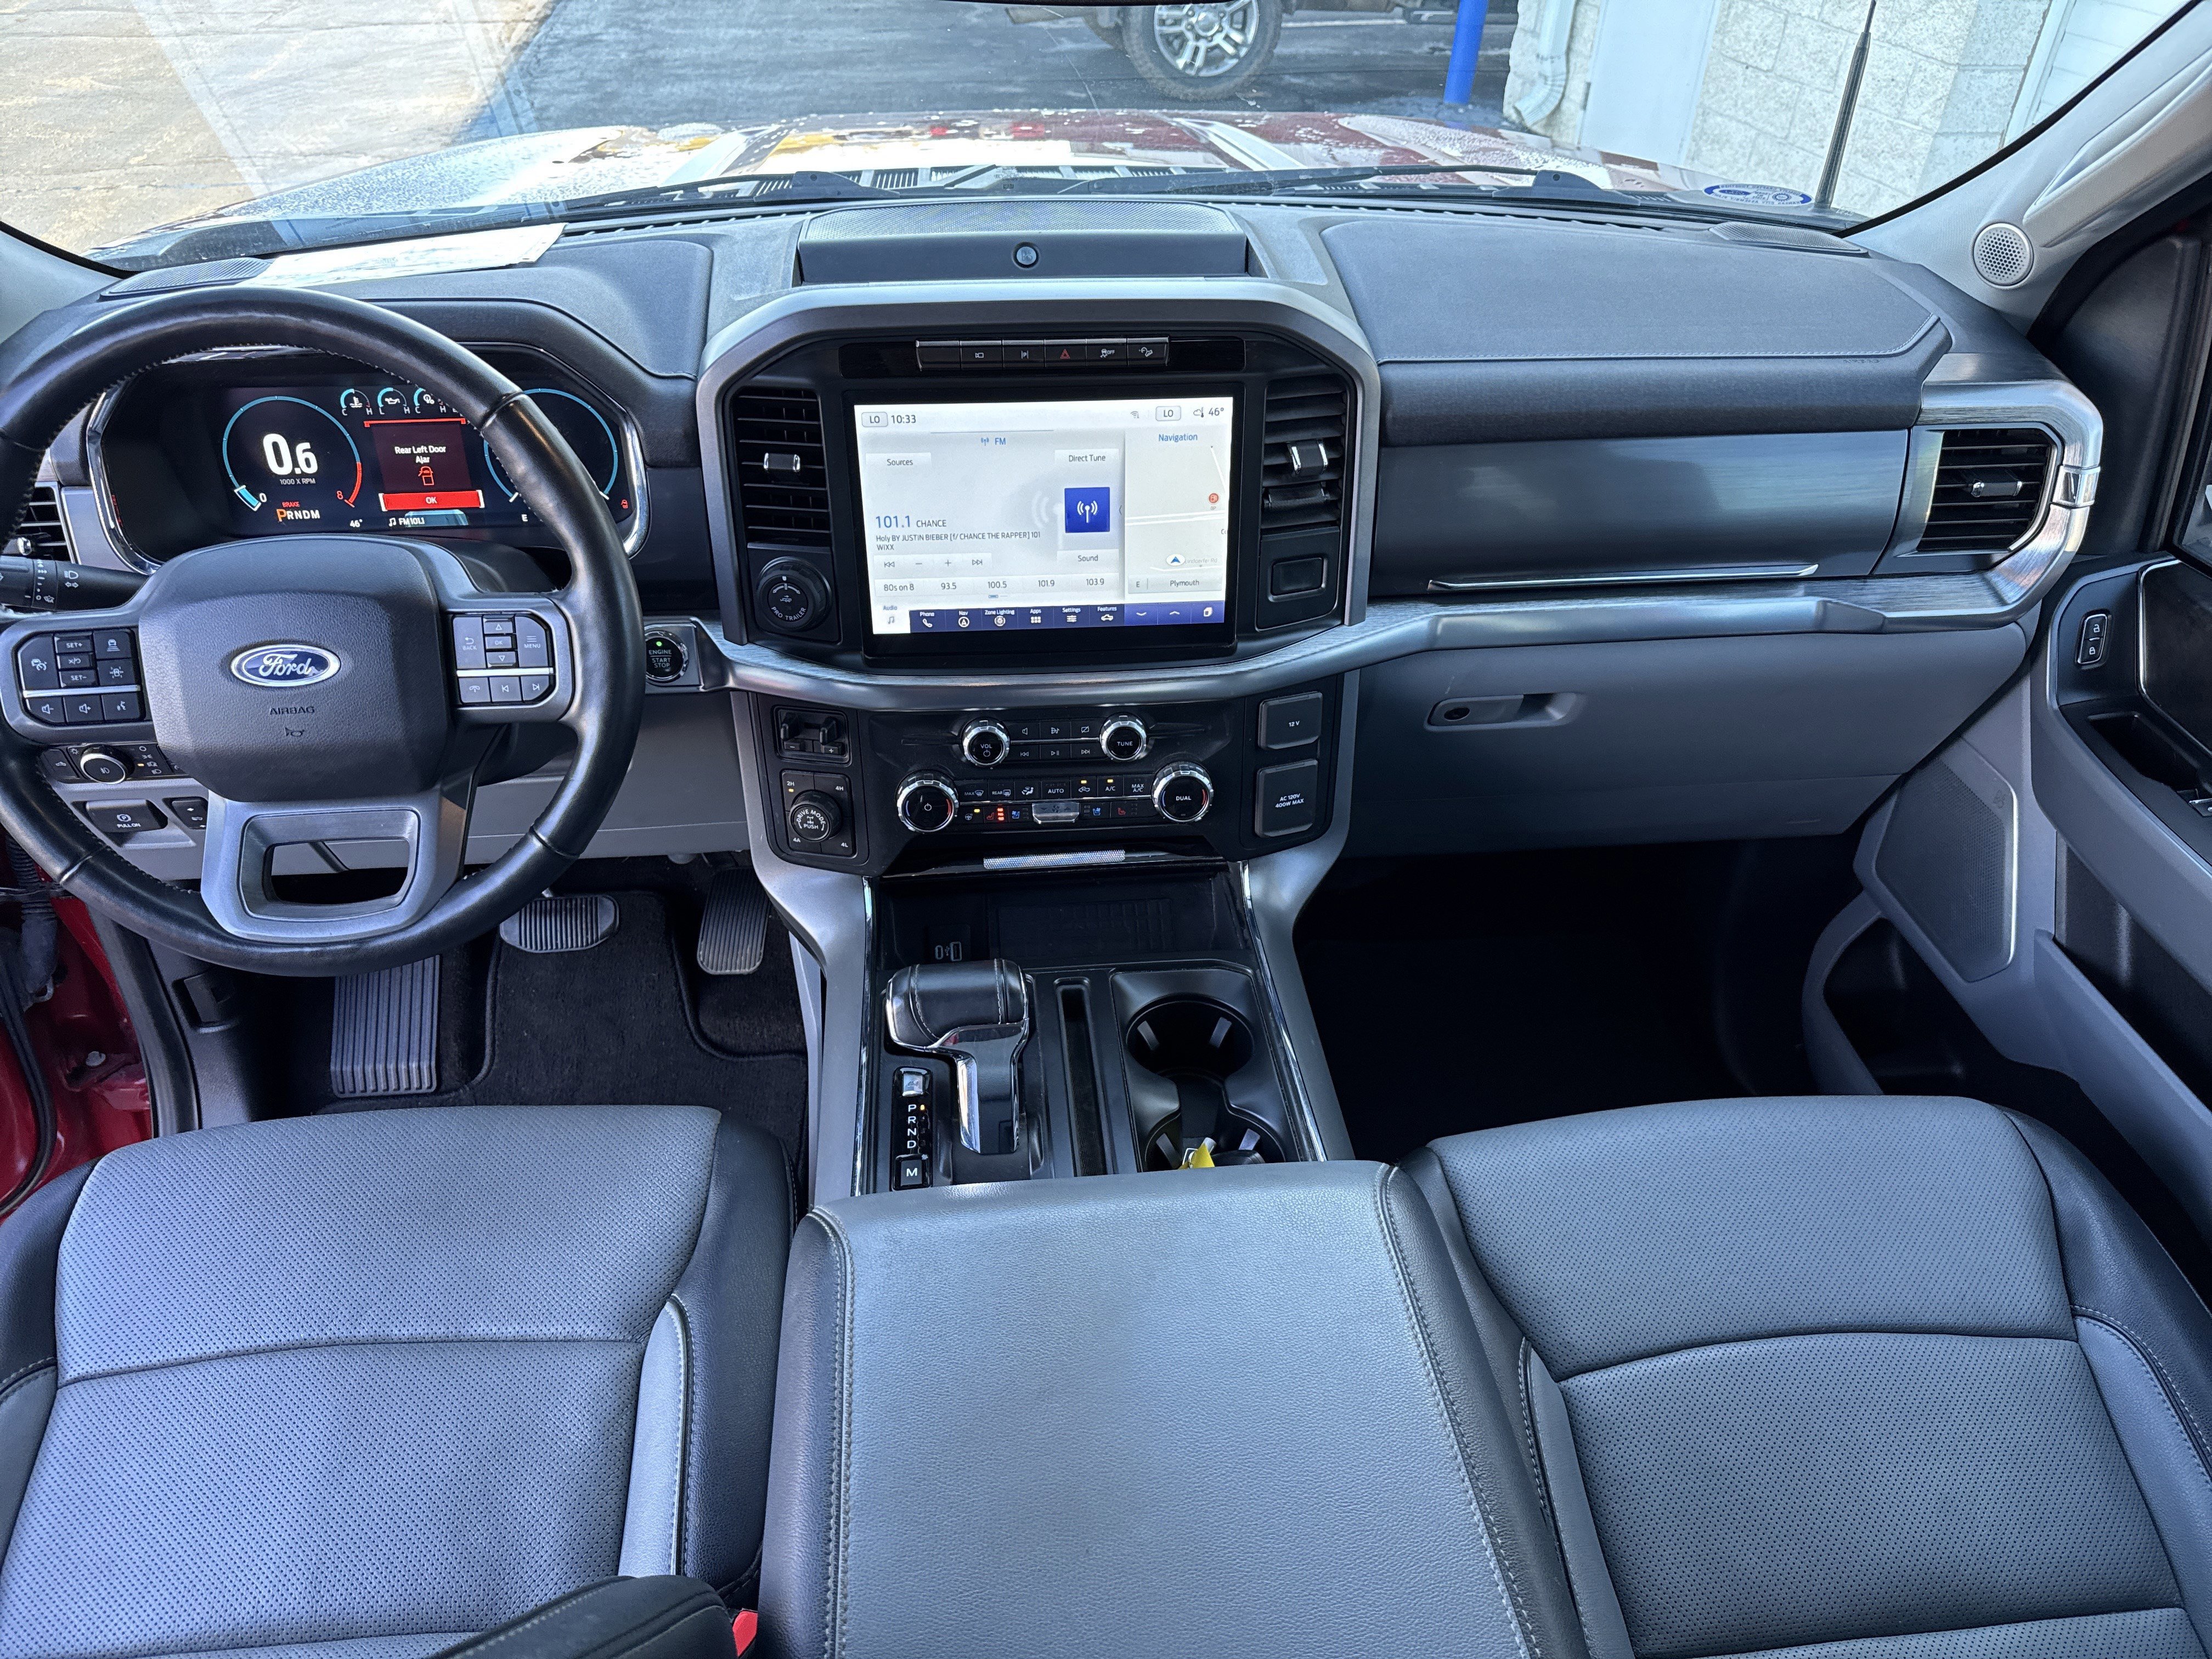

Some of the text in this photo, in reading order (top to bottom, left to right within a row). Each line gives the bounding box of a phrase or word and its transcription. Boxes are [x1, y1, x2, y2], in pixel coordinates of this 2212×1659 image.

[1208, 407, 1224, 416] 46°
[870, 415, 880, 424] LO
[891, 414, 916, 424] 10:33
[995, 437, 1006, 445] FM
[1158, 432, 1198, 443] Navigation
[263, 433, 318, 475] 0.6
[394, 446, 411, 454] Rear
[415, 455, 430, 464] Ajar
[259, 493, 267, 503] 0
[336, 490, 343, 500] 8
[521, 514, 528, 522] E
[876, 515, 947, 528] 101.1 CHANCE
[771, 606, 806, 621] PRO TRAILER
[259, 653, 312, 677] Ford
[269, 706, 315, 715] AIRBAG
[796, 809, 826, 825] DRIVE MODE
[908, 1104, 917, 1112] P
[907, 1127, 917, 1136] N
[907, 1140, 917, 1149] D
[906, 1167, 918, 1177] M
